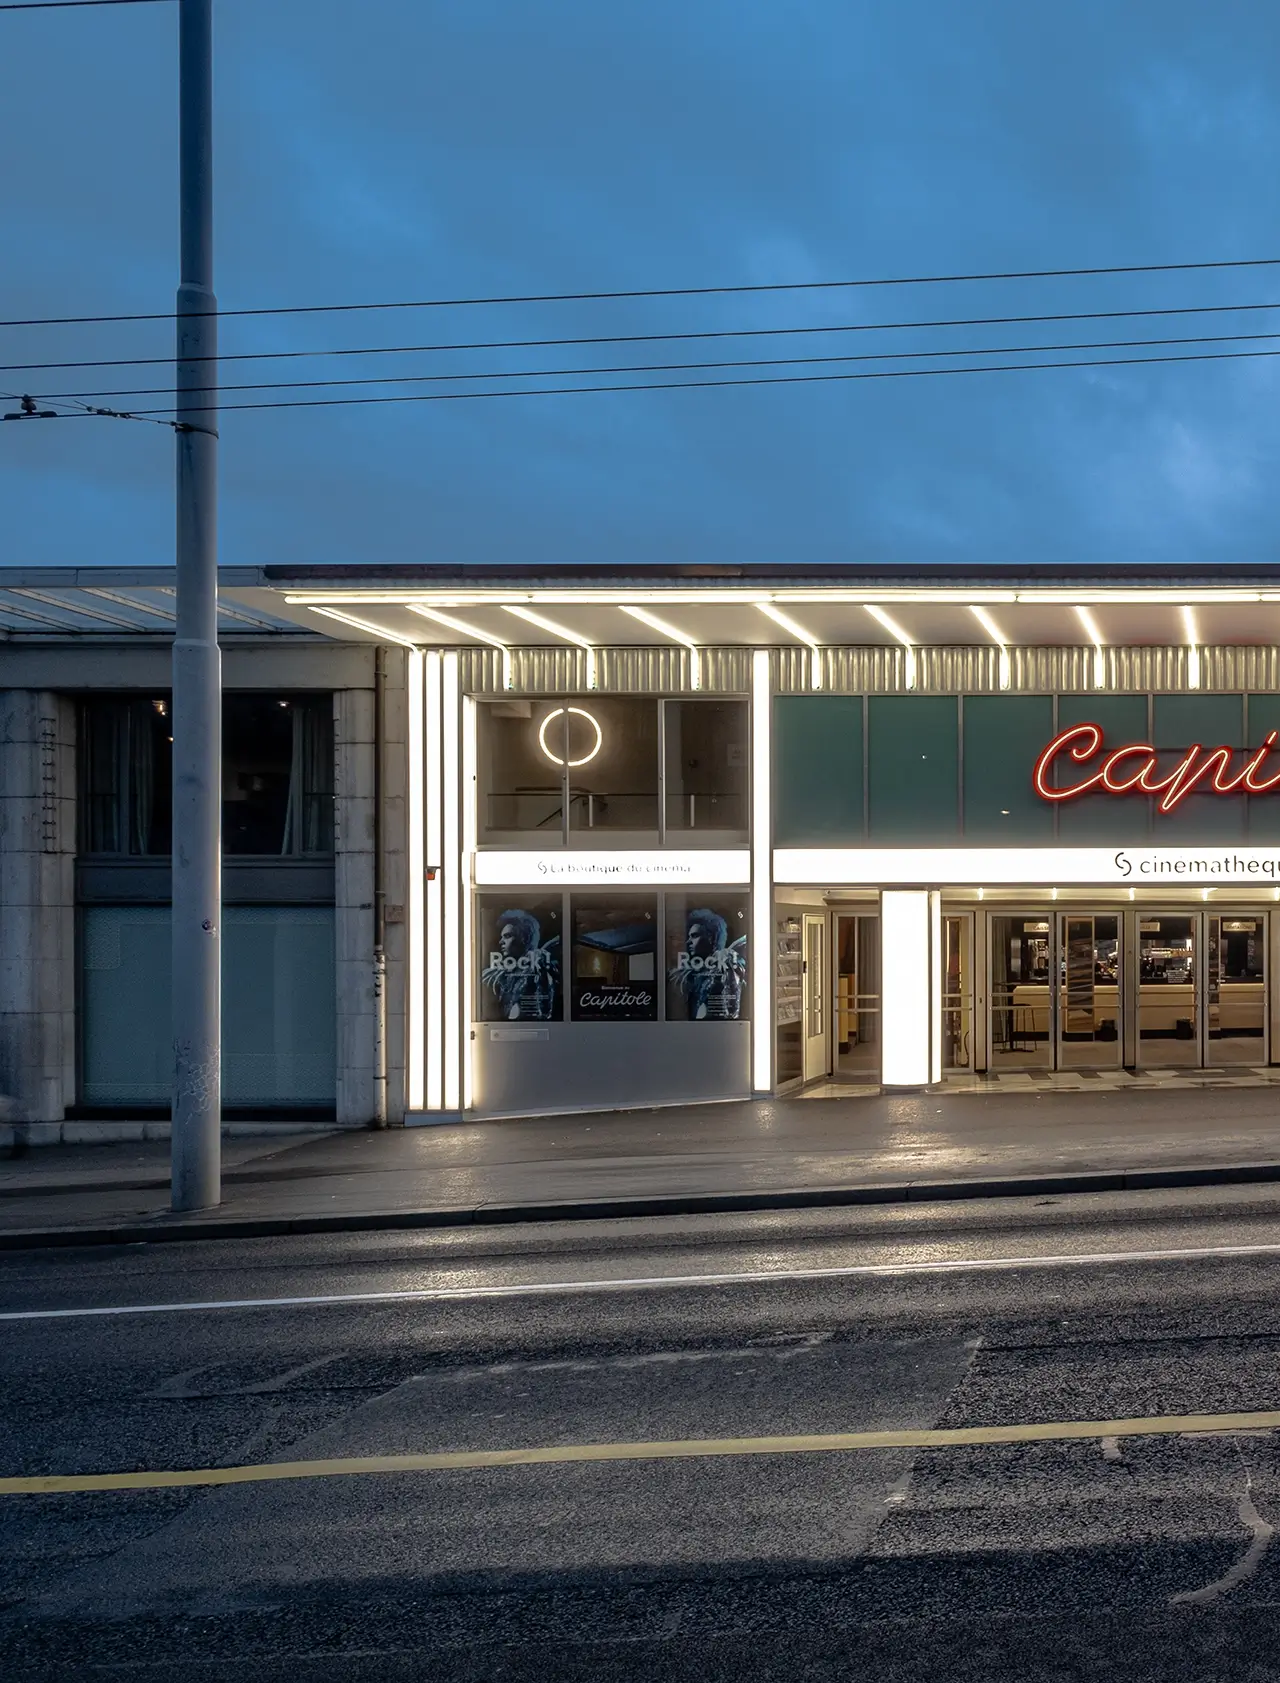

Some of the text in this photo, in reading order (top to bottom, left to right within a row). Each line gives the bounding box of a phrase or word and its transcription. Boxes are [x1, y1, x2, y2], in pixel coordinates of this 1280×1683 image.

[489, 950, 551, 970] Rock!
[677, 950, 738, 970] Rock!
[580, 991, 652, 1009] Capitole
